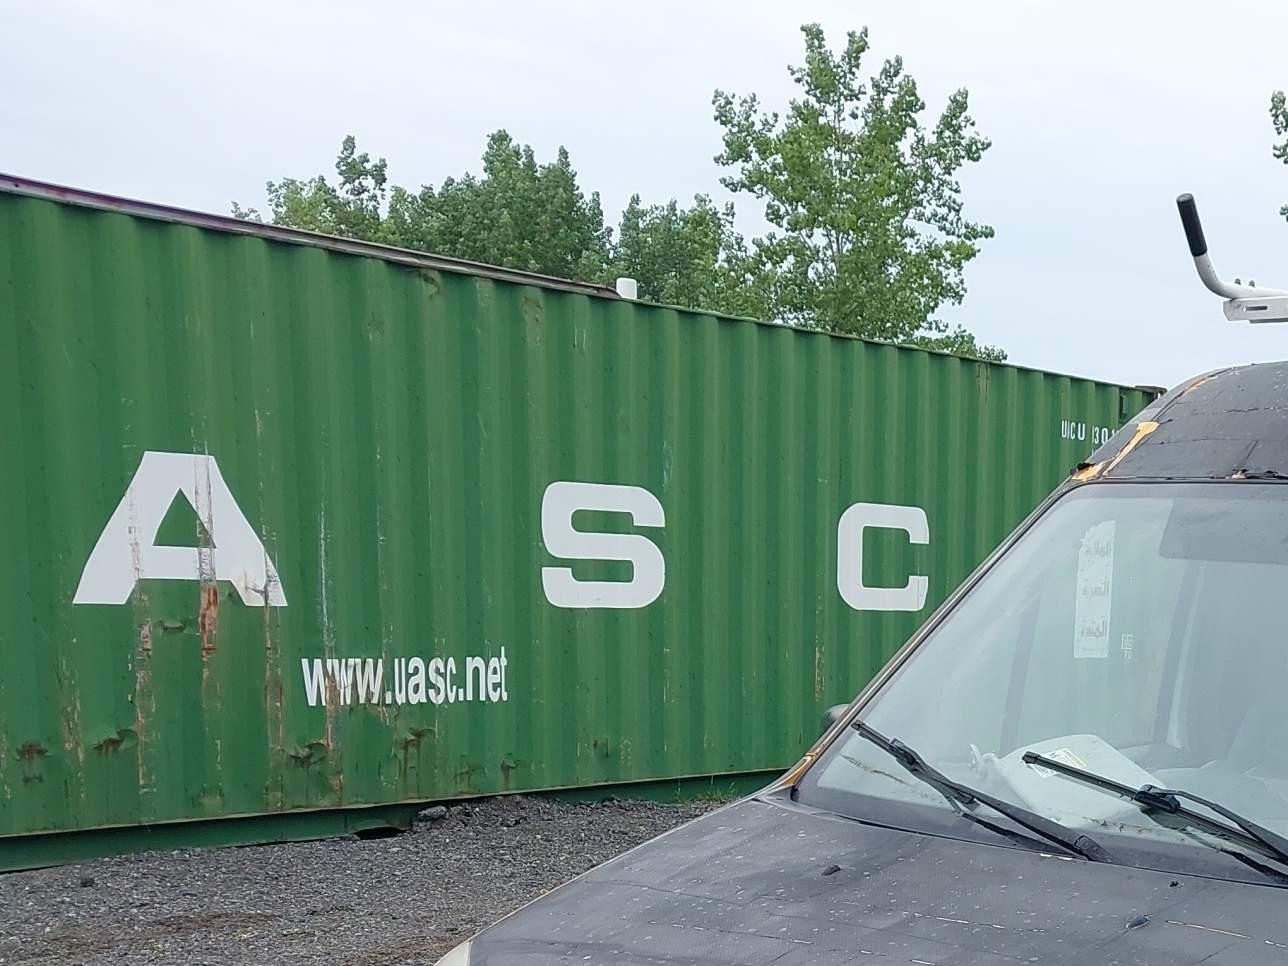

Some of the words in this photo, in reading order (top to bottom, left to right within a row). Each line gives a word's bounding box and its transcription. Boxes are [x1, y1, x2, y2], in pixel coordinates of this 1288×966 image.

[73, 450, 288, 607] A
[541, 481, 666, 609] S
[837, 502, 930, 612] C
[301, 645, 508, 706] www.uasc.net
